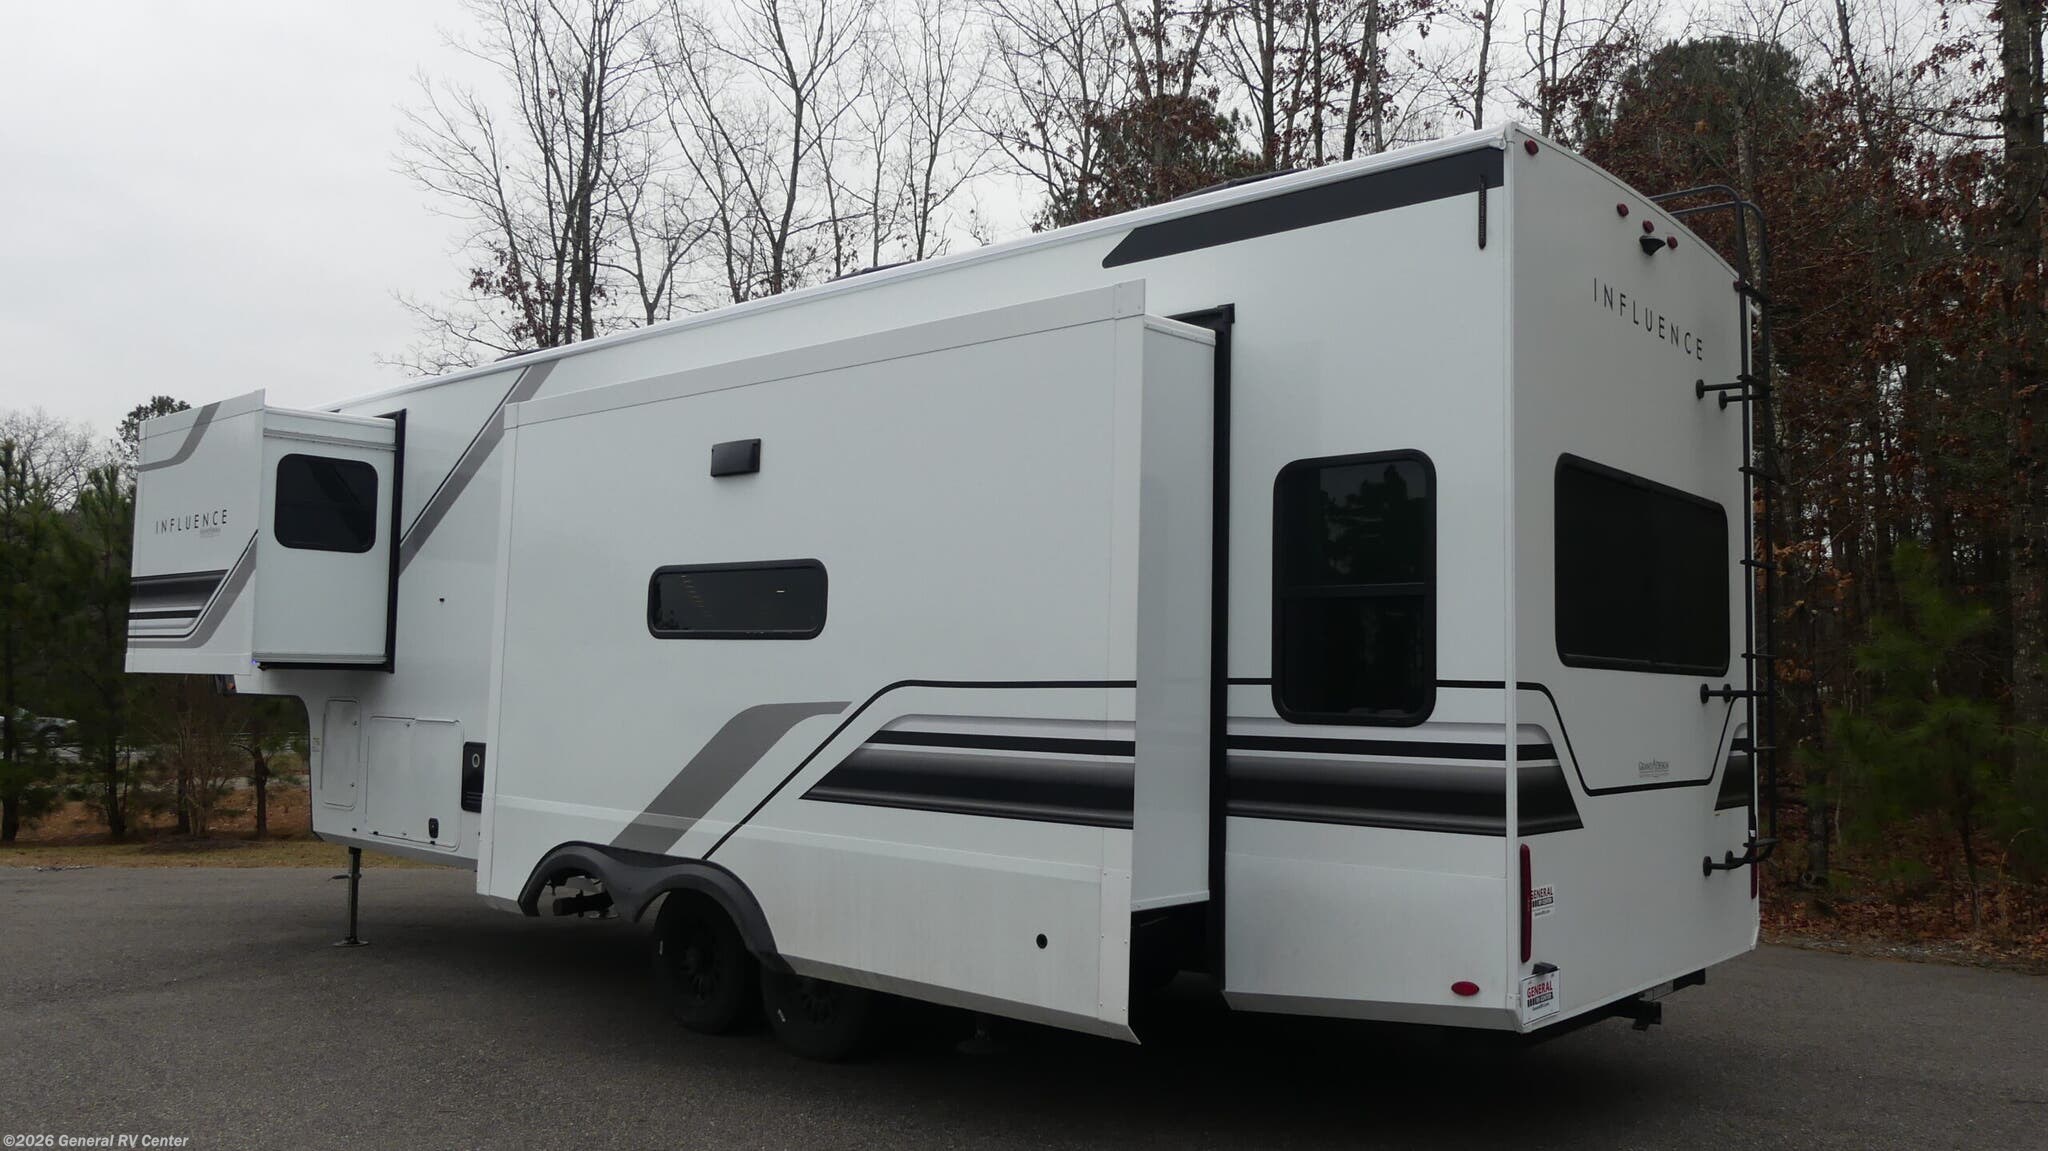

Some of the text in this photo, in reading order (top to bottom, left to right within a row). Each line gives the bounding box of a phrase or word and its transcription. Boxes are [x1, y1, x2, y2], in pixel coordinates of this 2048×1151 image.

[1593, 277, 1703, 361] INFLUENCE
[155, 509, 228, 534] INFLUENCE
[1527, 980, 1553, 998] GENERAL
